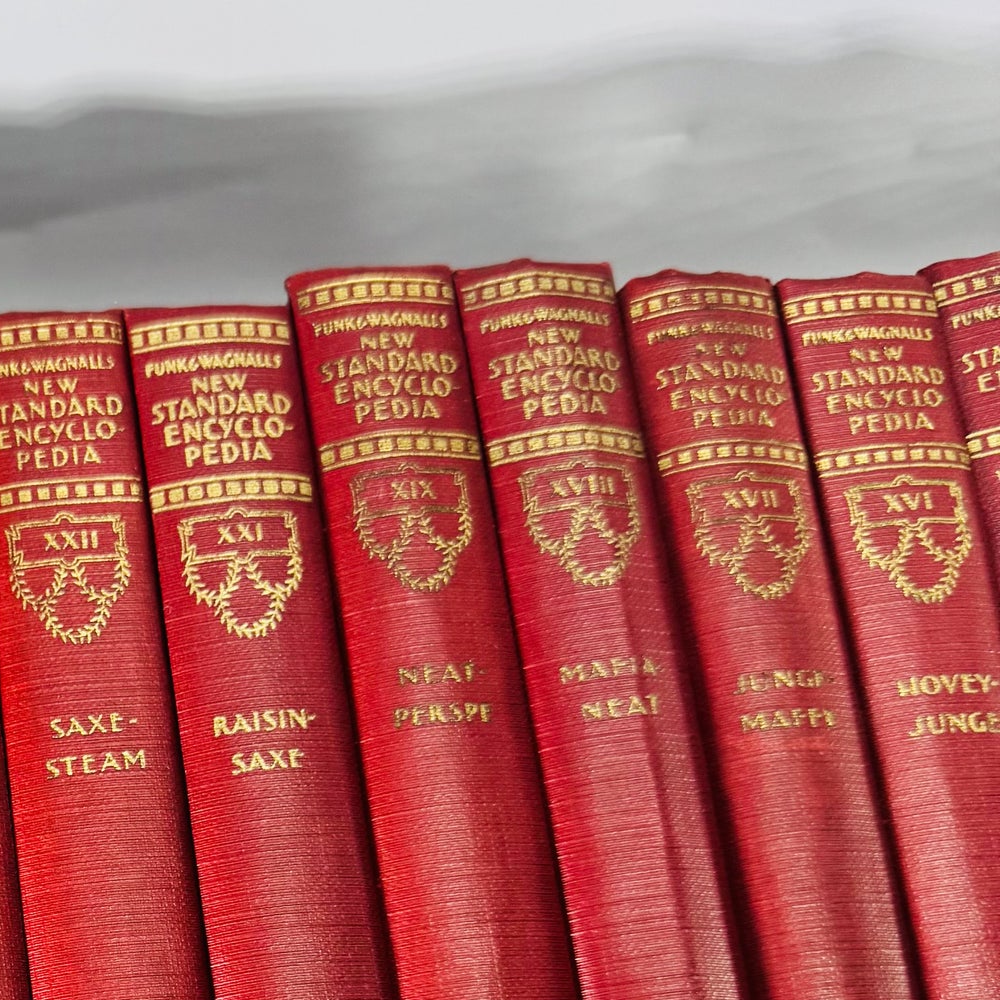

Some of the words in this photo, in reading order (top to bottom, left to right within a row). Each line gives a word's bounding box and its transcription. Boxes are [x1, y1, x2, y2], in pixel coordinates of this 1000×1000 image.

[359, 331, 415, 351] NEW
[527, 328, 582, 347] NEW
[488, 346, 621, 380] STANDARD
[849, 346, 903, 363] NEW
[320, 351, 458, 384] STANDARD
[655, 360, 786, 391] STANDARD
[811, 365, 946, 393] STANDARD
[23, 376, 78, 396] NEW
[191, 373, 248, 394] NEW
[151, 391, 292, 425] STANDARD
[354, 399, 441, 424] PEDIA
[523, 394, 607, 420] PEDIA
[692, 409, 775, 429] PEDIA
[163, 416, 294, 448] ENCYCLO-
[848, 412, 935, 435] PEDIA
[17, 446, 101, 471] PEDIA
[184, 440, 273, 468] PEDIA
[391, 479, 437, 500] XIX
[551, 474, 616, 498] XVIII
[722, 489, 779, 509] XVII
[883, 491, 934, 513] XVI
[43, 530, 99, 551] XXII
[217, 522, 264, 545] XXI
[896, 673, 999, 697] HOVEY-
[50, 711, 138, 739] SAXE-
[213, 708, 317, 738] RAISIN-
[45, 749, 146, 780] STEAM
[231, 748, 305, 776] SAXE
